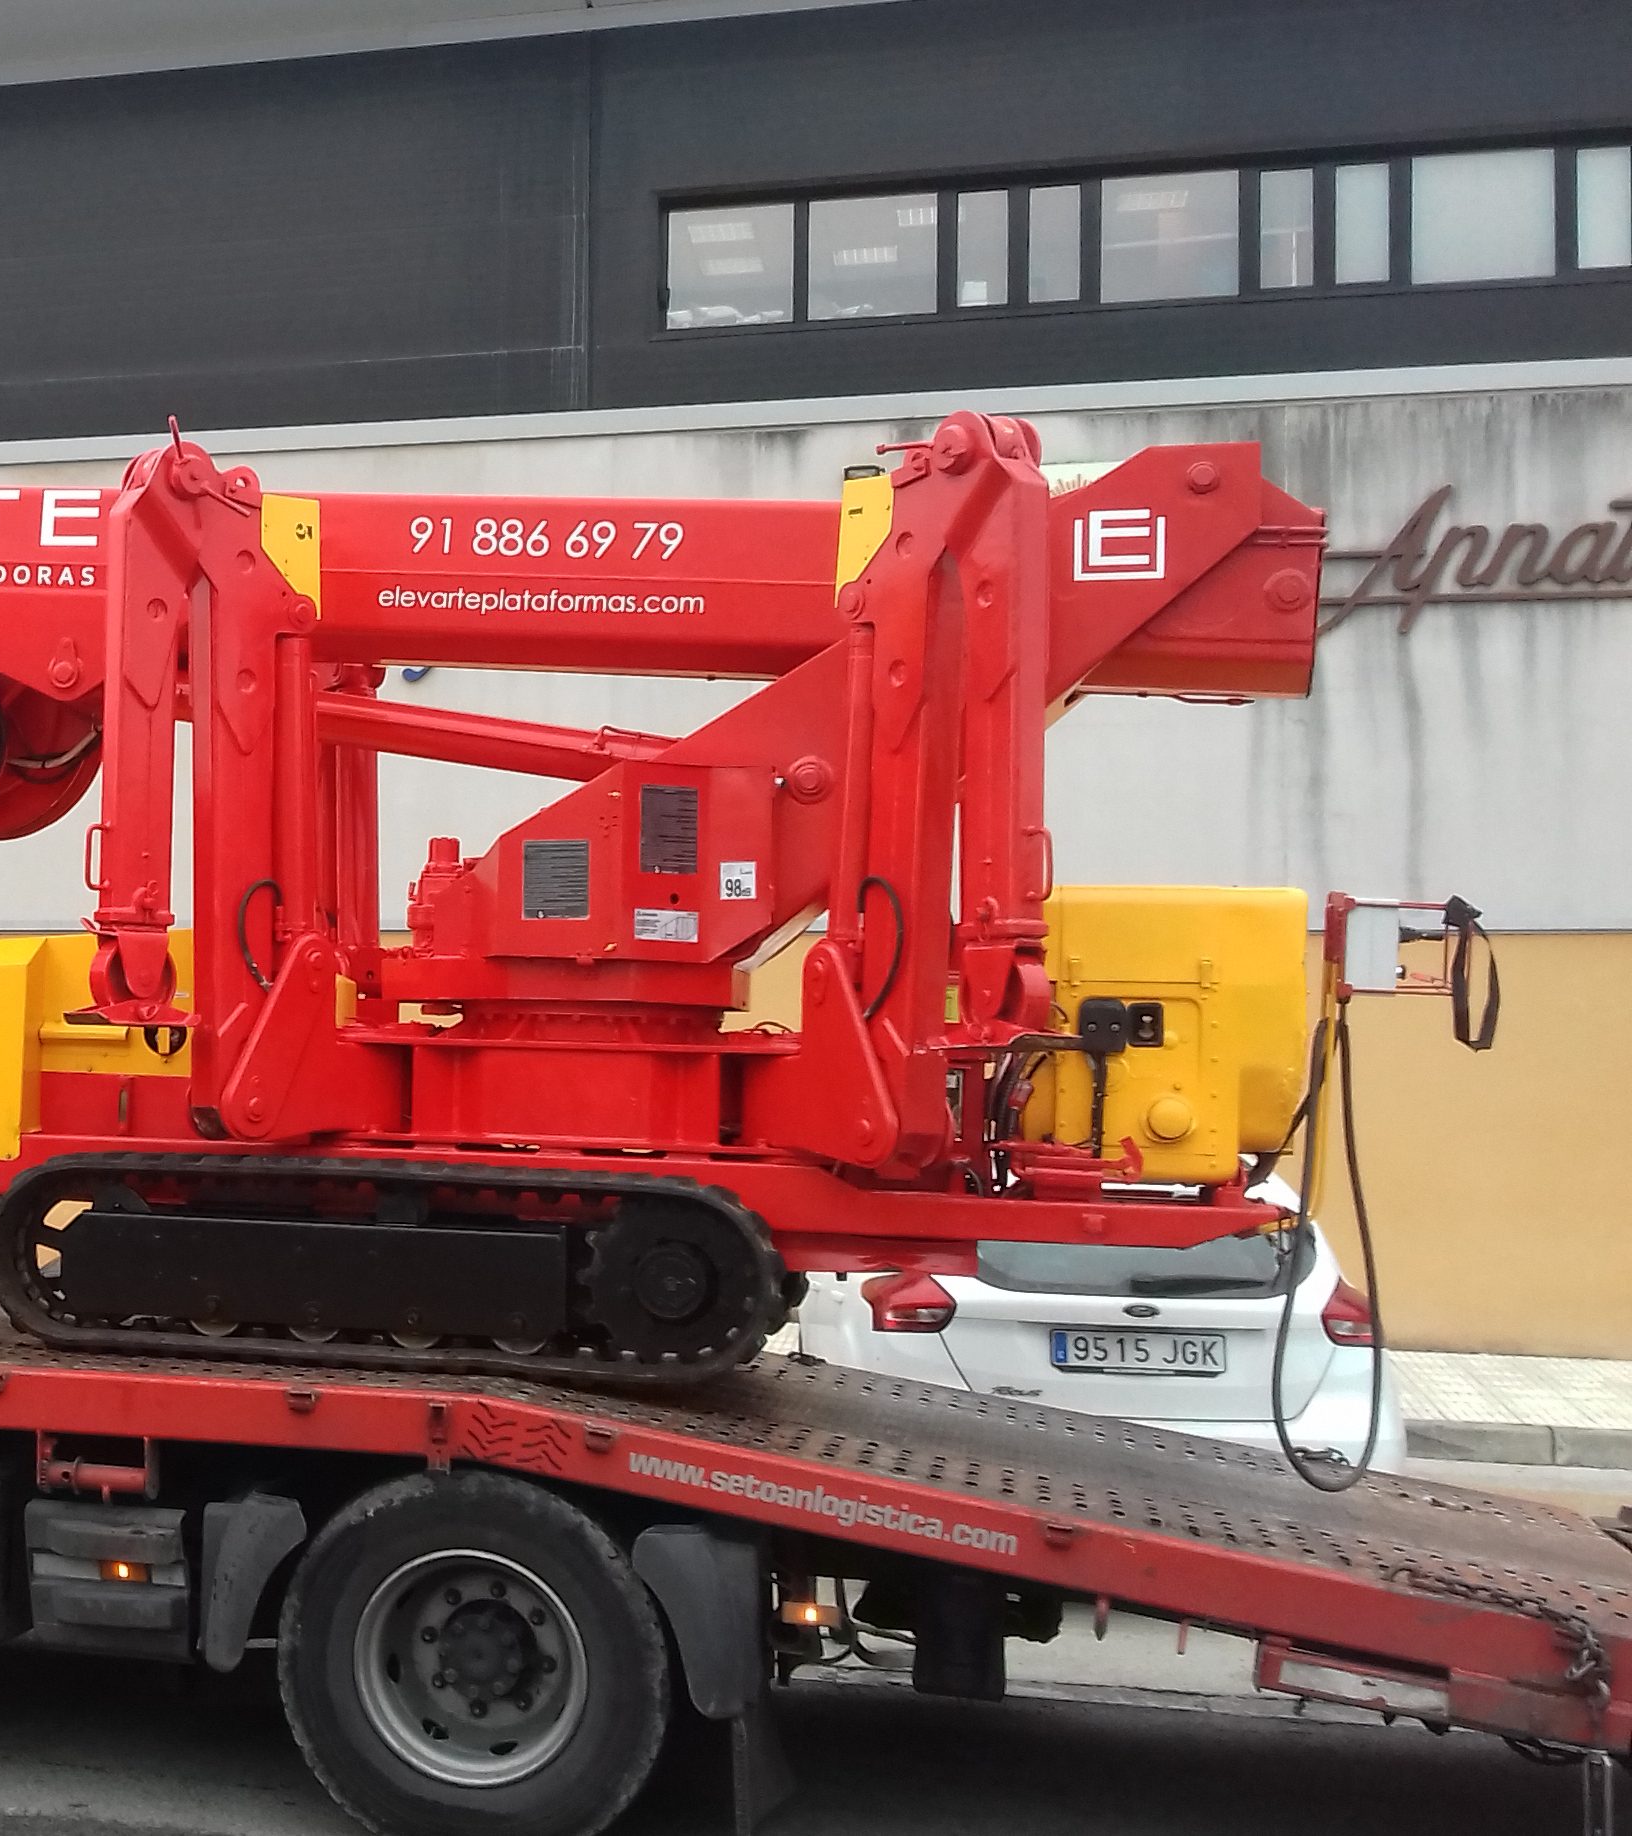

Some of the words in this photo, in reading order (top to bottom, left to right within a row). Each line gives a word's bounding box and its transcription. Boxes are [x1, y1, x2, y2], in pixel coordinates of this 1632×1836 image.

[410, 516, 453, 554] 91
[472, 518, 549, 557] 886
[565, 520, 616, 559] 69
[631, 522, 684, 561] 79
[378, 586, 705, 615] elevarteplataformas.com
[1073, 1335, 1150, 1363] 9515
[1162, 1338, 1219, 1366] JGK
[629, 1452, 1018, 1556] www.setoanlogistica.com
